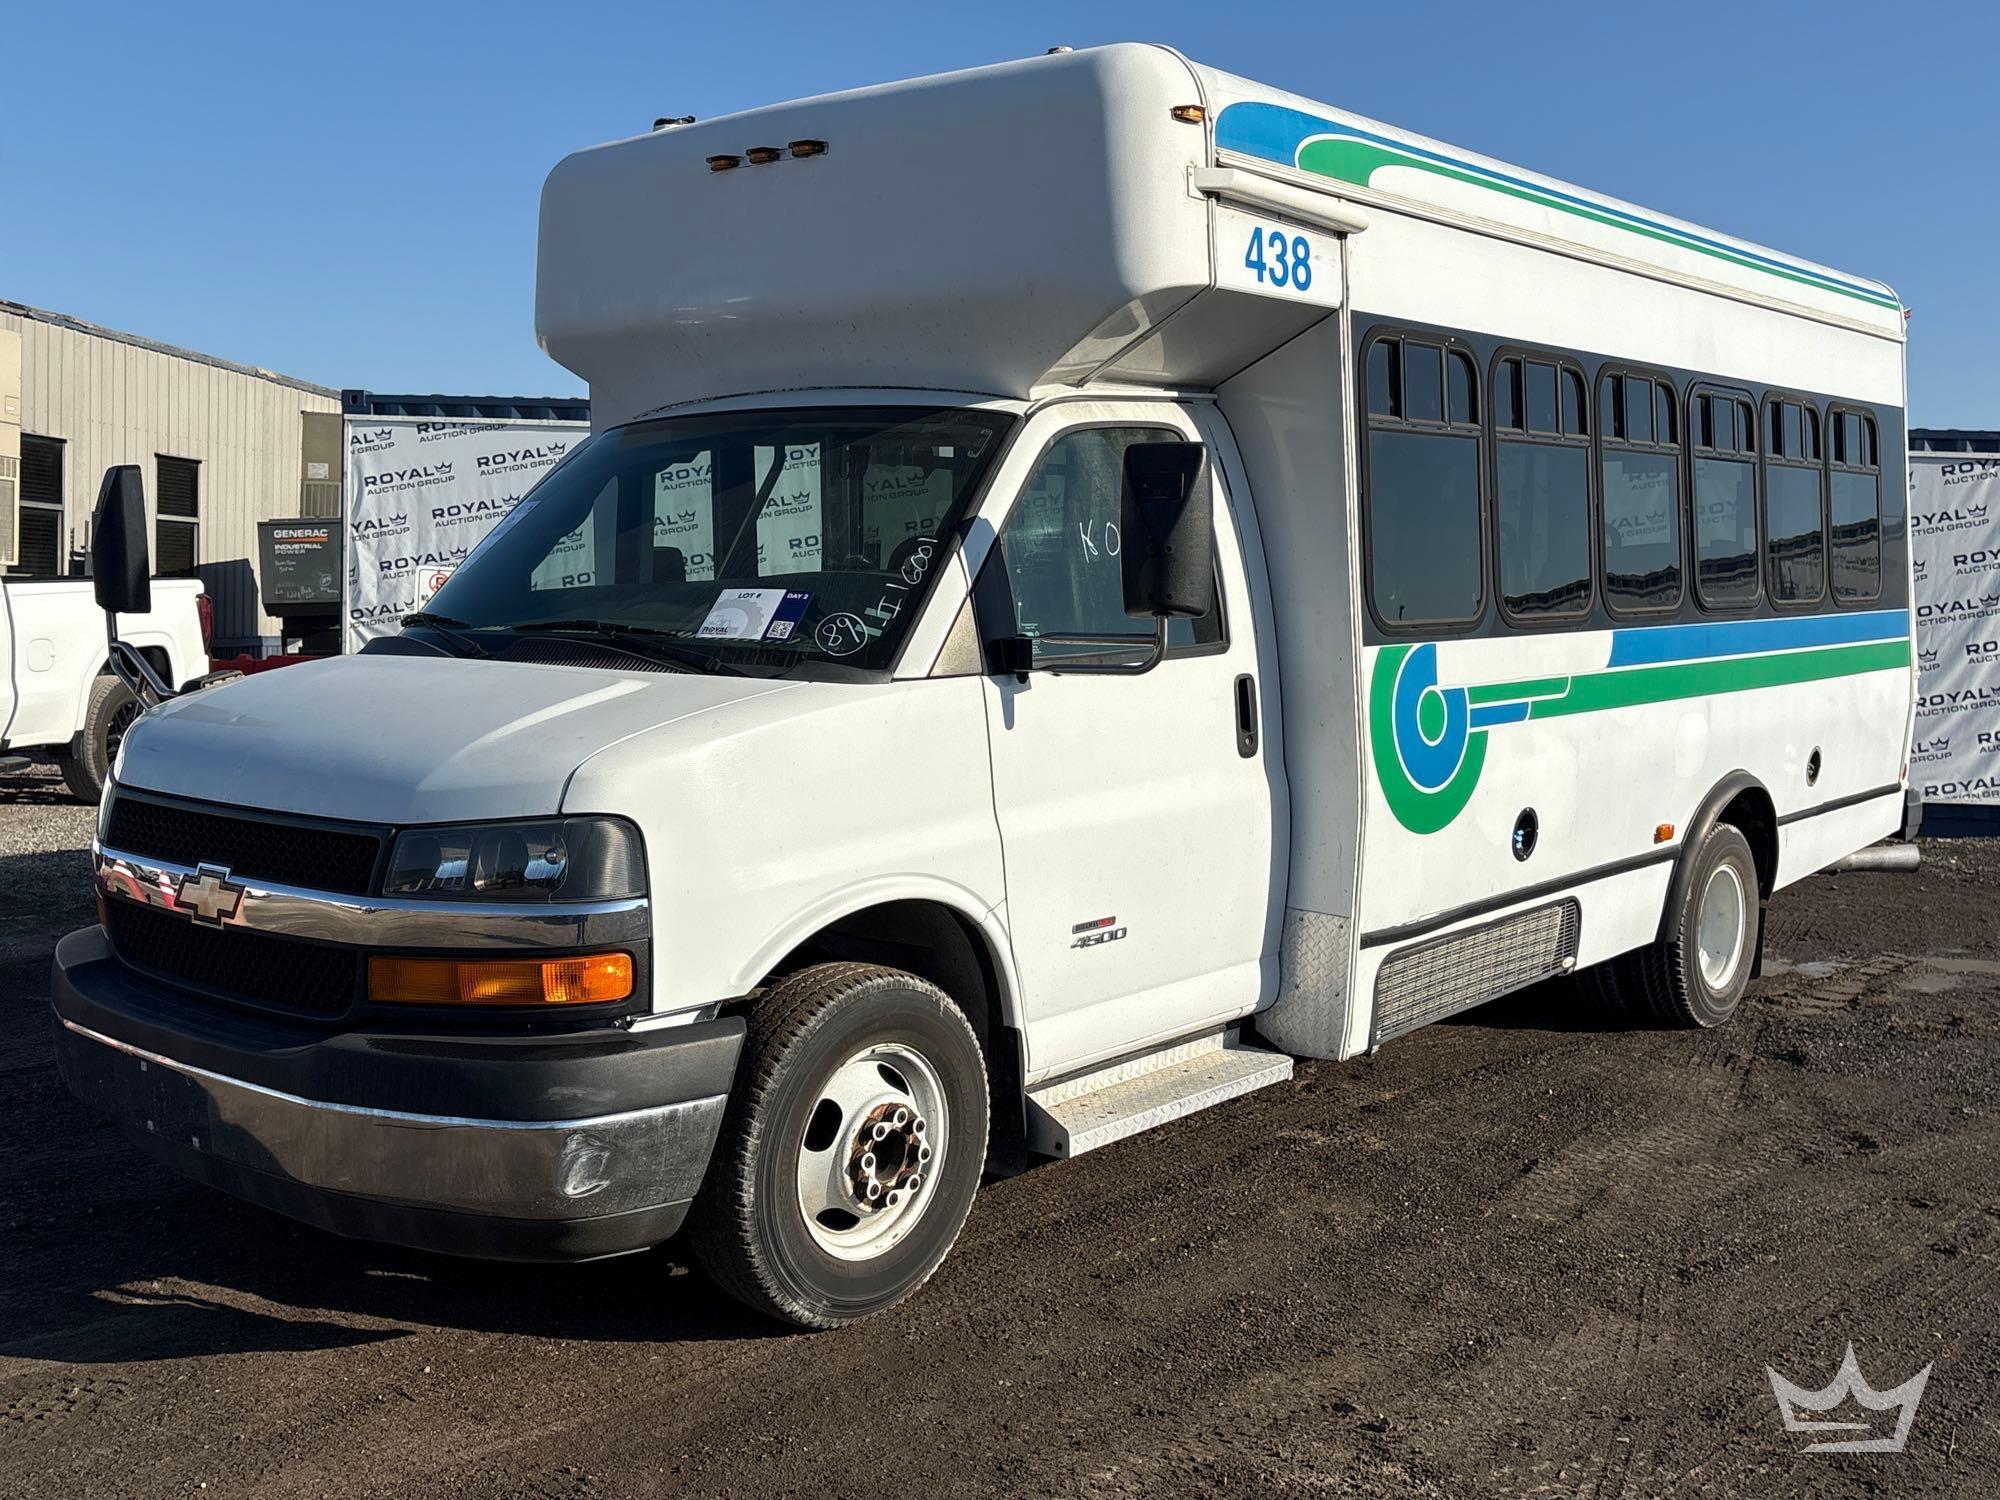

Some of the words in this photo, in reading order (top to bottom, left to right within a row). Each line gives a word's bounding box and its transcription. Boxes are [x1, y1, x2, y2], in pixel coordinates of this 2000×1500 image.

[1245, 226, 1312, 292] 438
[419, 427, 468, 443] AUCTION
[356, 441, 396, 455] GROUP
[476, 447, 548, 468] ROYAL
[364, 466, 435, 487] ROYAL
[479, 463, 528, 477] AUCTION
[367, 482, 415, 496] AUCTION
[416, 475, 456, 487] GROUP
[663, 477, 711, 491] AUCTION
[1943, 471, 1998, 486] AUCTION
[888, 488, 929, 499] GROUP
[431, 499, 503, 520] ROYAL
[773, 505, 813, 517] GROUP
[434, 514, 483, 528] AUCTION
[1946, 518, 1990, 531] GROUP
[273, 528, 329, 538] GENERAC
[371, 526, 411, 539] GROUP
[660, 523, 699, 536] GROUP
[379, 551, 450, 572] ROYAL
[786, 592, 803, 600] DAY
[702, 626, 729, 634] ROYAL
[822, 616, 860, 646] 89
[1917, 688, 1991, 708] ROYAL
[1915, 704, 1968, 718] AUCTION
[1070, 926, 1128, 949] 4500
